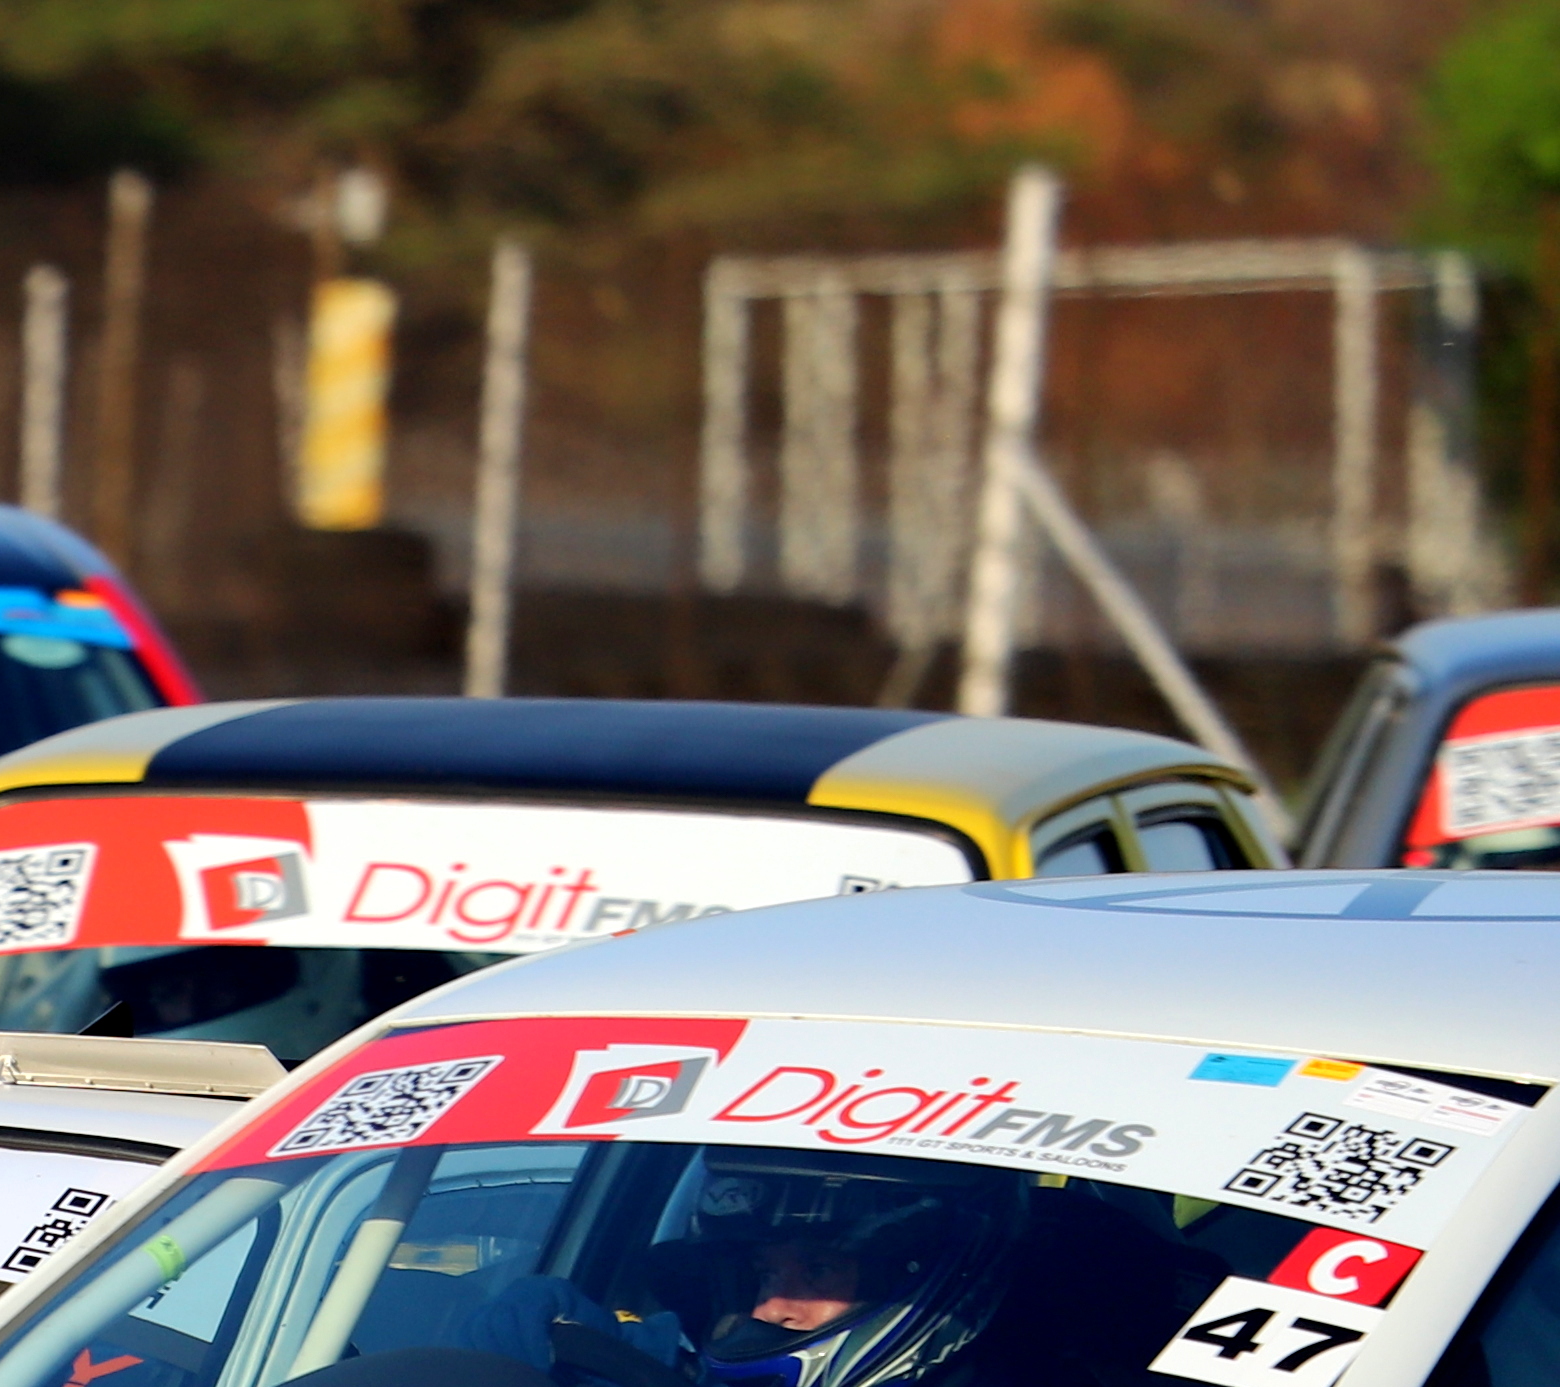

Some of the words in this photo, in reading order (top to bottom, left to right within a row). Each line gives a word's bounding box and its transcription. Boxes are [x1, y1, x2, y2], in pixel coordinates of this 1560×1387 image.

[709, 1065, 1158, 1158] DigitFMS
[916, 1138, 945, 1151] GT
[946, 1140, 1019, 1159] SPORTS
[1021, 1149, 1035, 1160] &
[1037, 1152, 1128, 1173] SALOONS
[1307, 1239, 1389, 1296] C
[1181, 1306, 1370, 1374] 47
